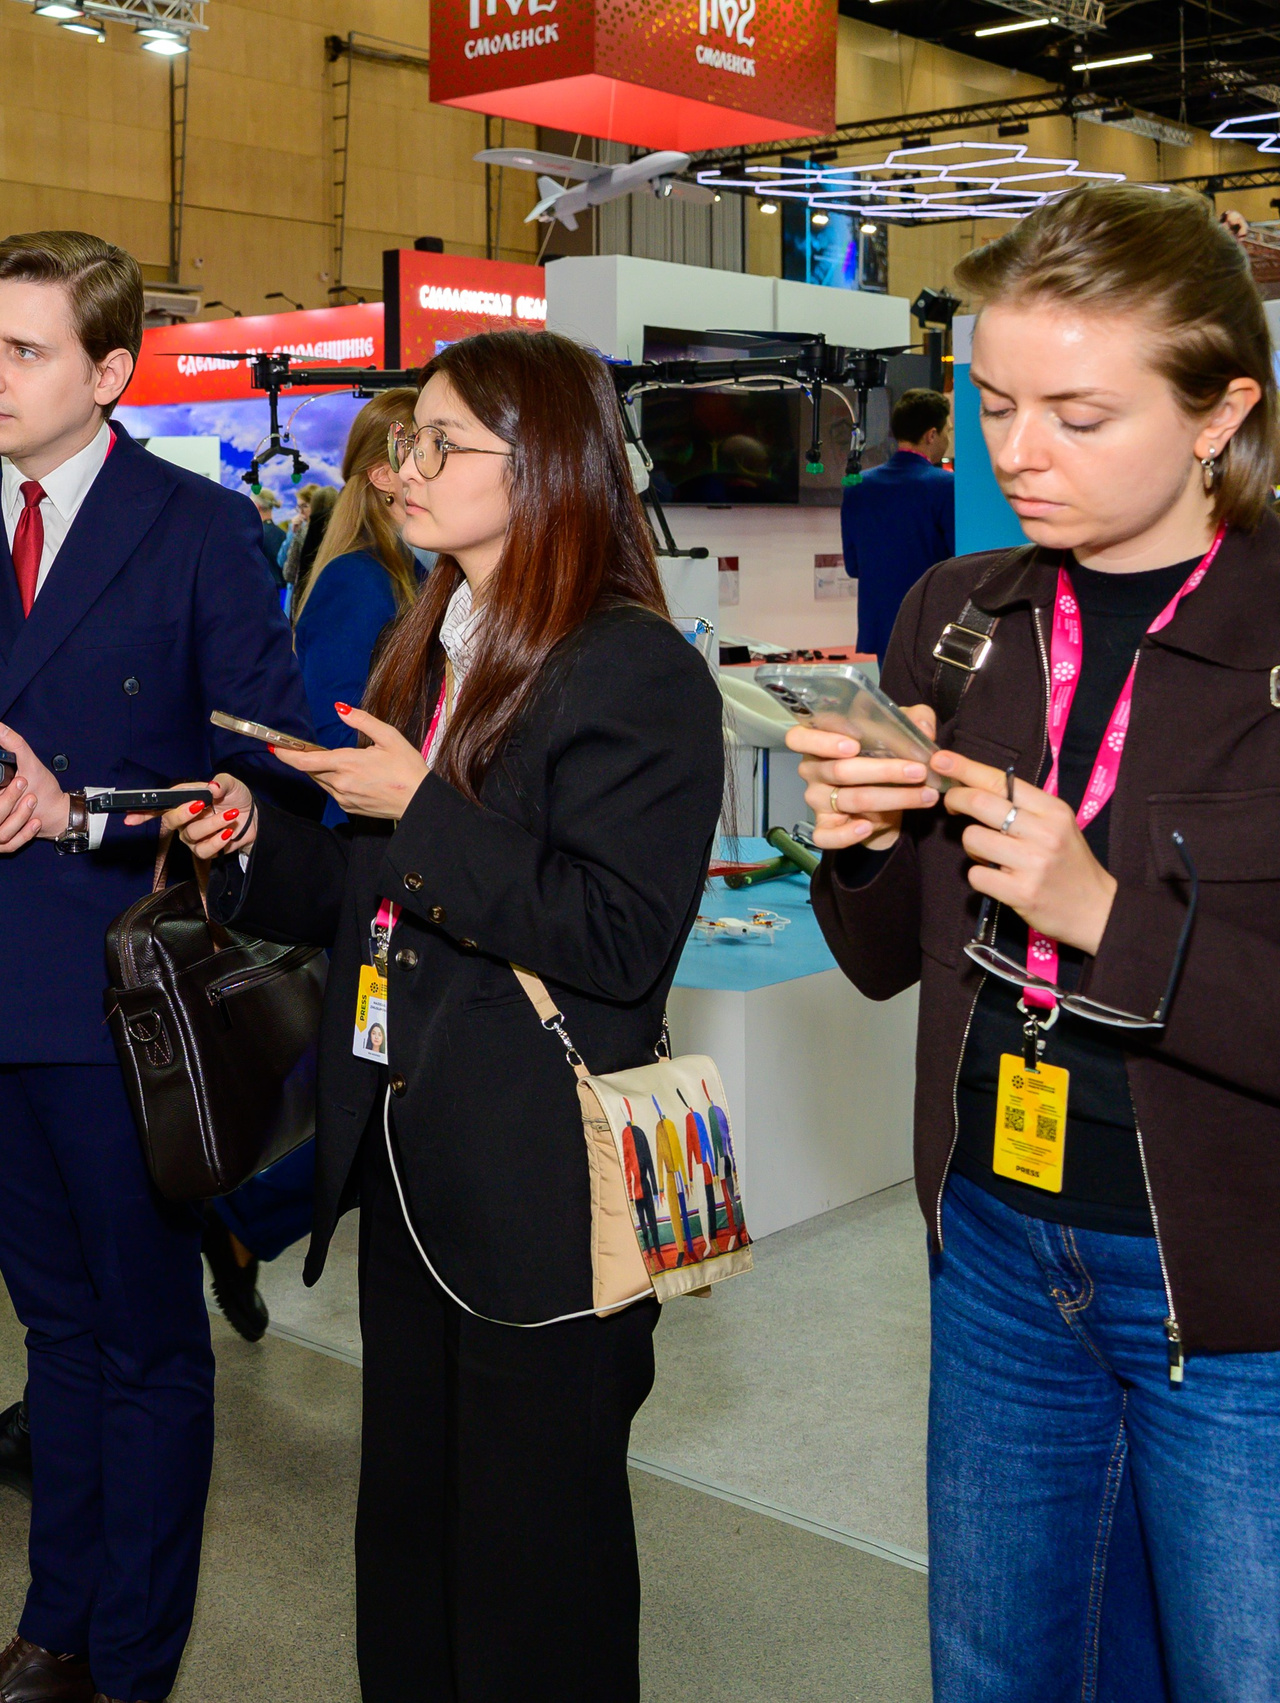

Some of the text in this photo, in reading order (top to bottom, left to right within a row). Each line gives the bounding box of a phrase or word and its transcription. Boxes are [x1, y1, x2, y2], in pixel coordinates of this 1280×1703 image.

[464, 22, 560, 60] СМОЛЕНСК
[696, 44, 756, 78] СМОЛЕНСК
[1015, 1165, 1040, 1178] PRESS
